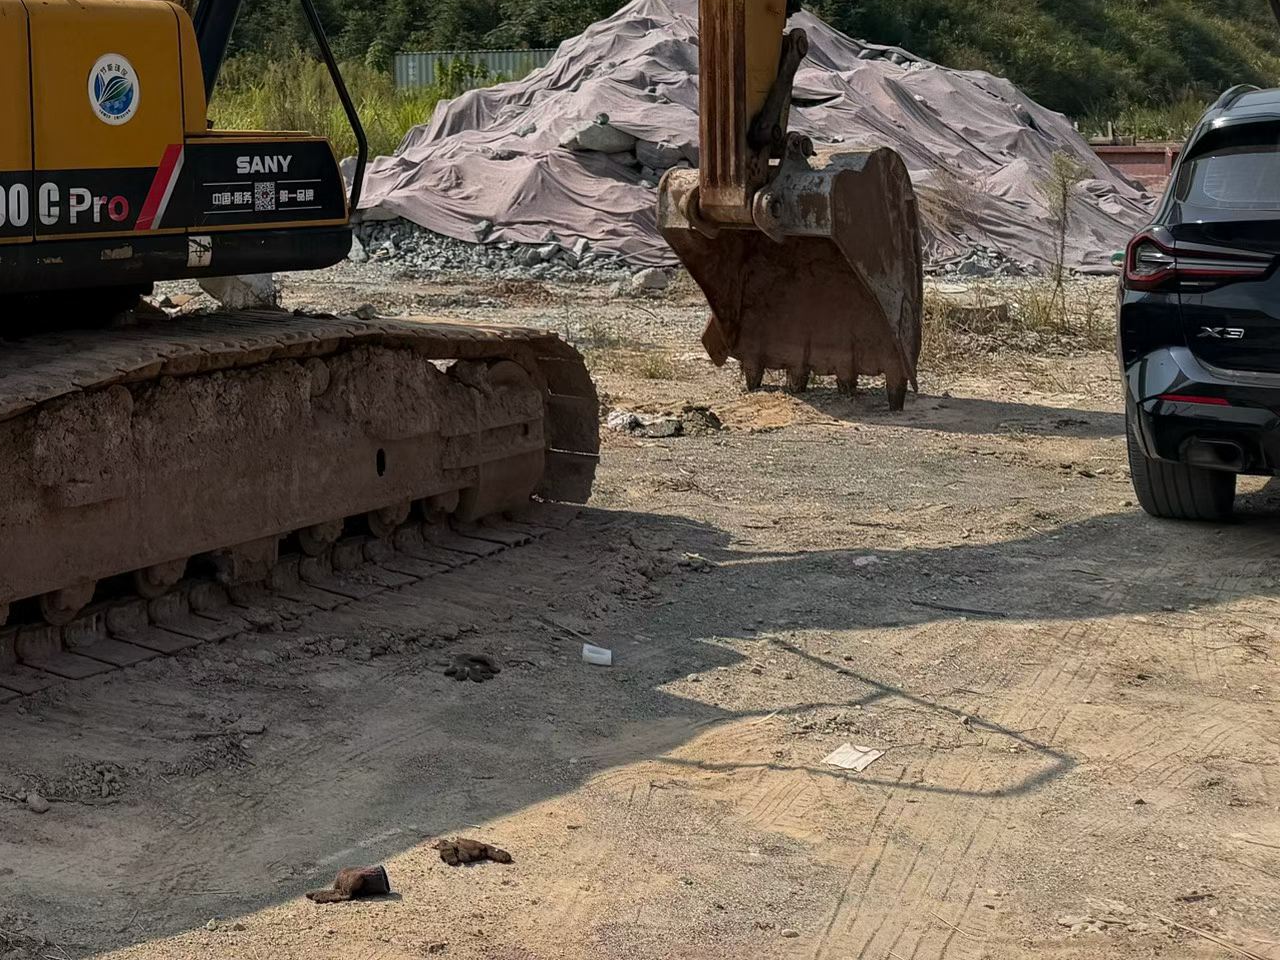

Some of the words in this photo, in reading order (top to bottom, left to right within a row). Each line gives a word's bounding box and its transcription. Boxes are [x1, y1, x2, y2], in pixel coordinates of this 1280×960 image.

[236, 155, 292, 174] SANY
[69, 187, 129, 224] Pro
[1196, 326, 1245, 340] X3
